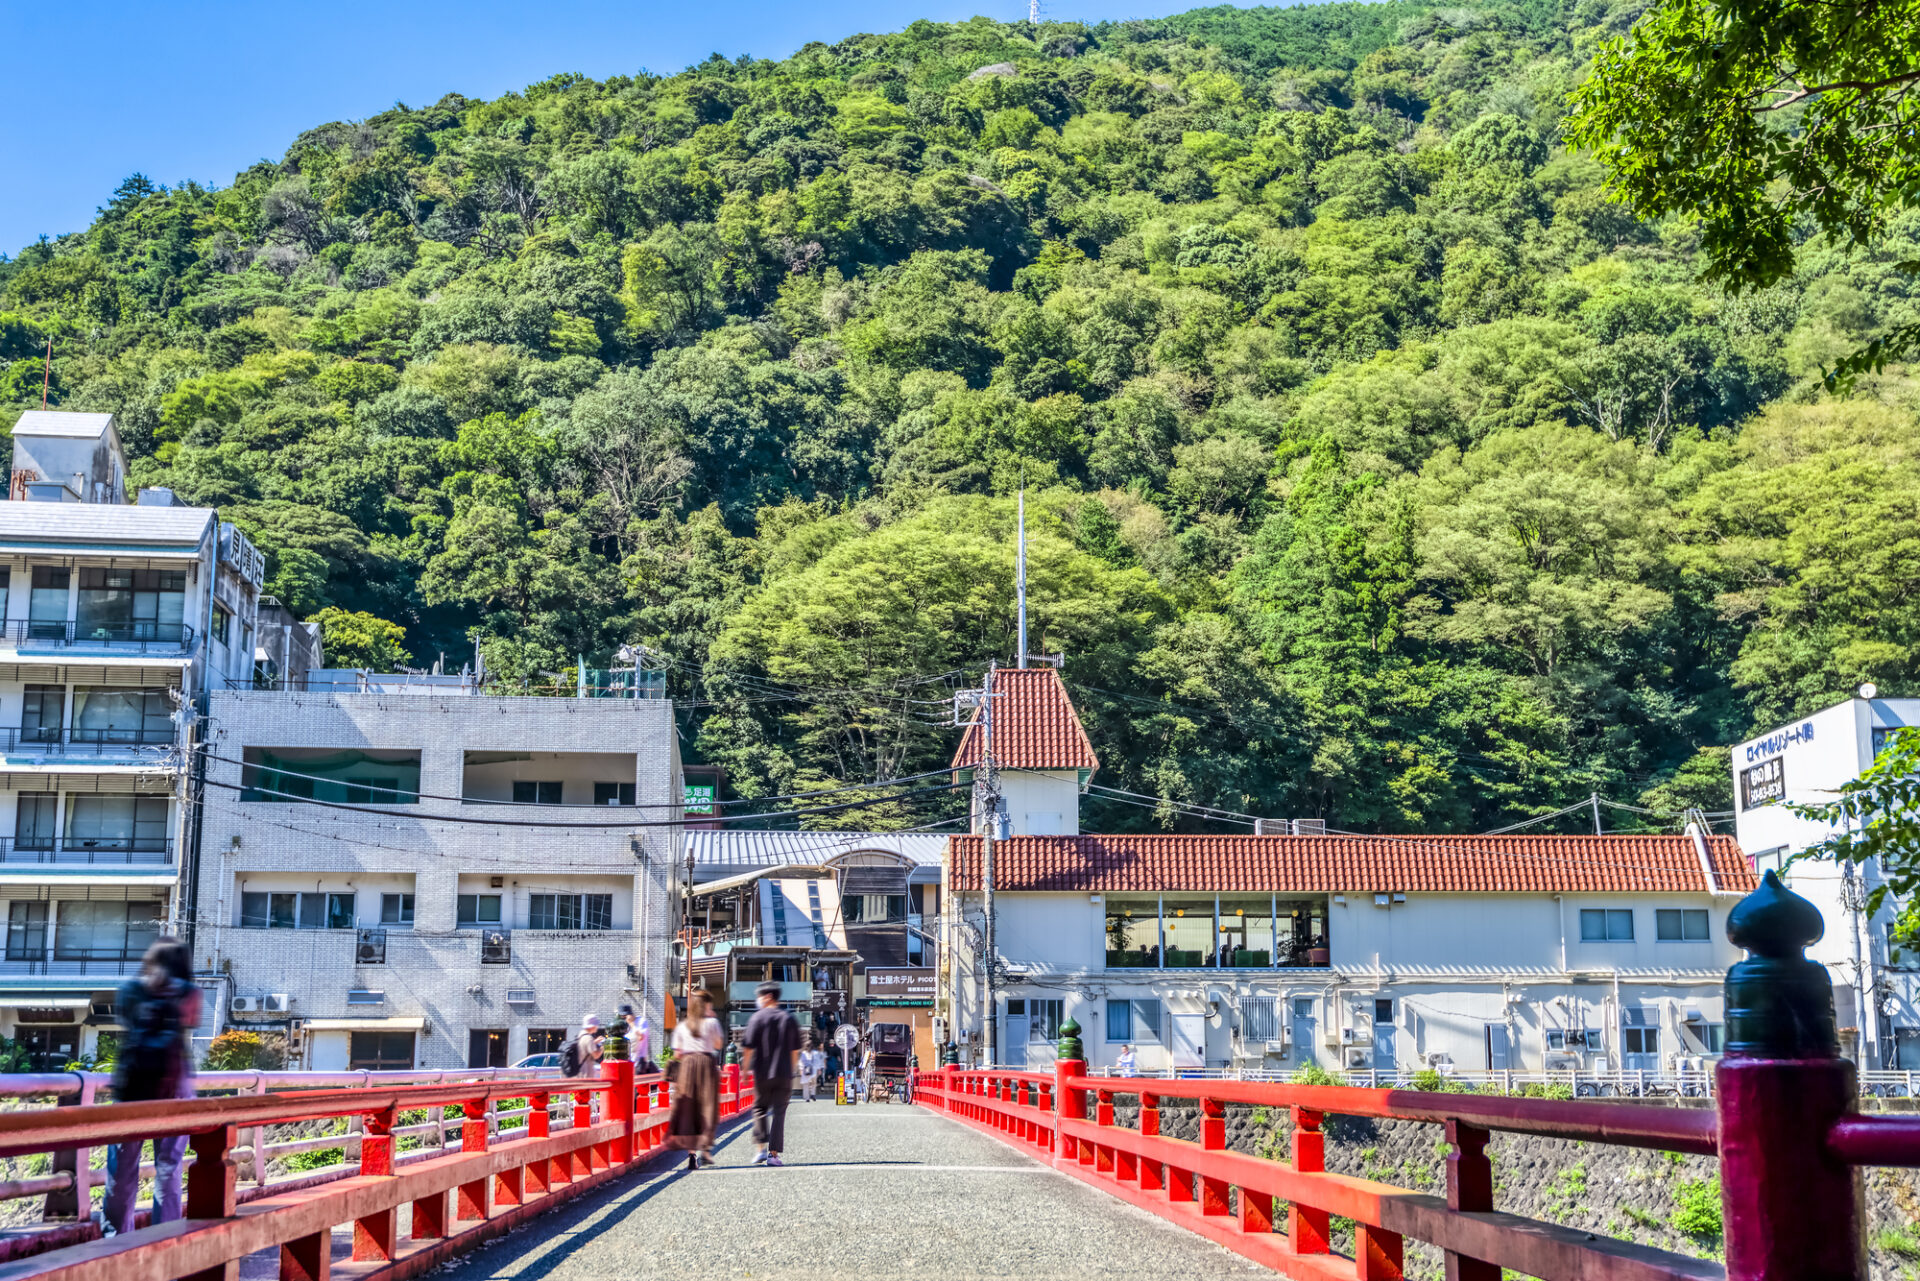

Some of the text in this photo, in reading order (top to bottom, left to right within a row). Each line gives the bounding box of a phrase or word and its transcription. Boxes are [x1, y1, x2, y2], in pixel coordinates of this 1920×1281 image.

[870, 976, 914, 985] 富士屋ホテル
